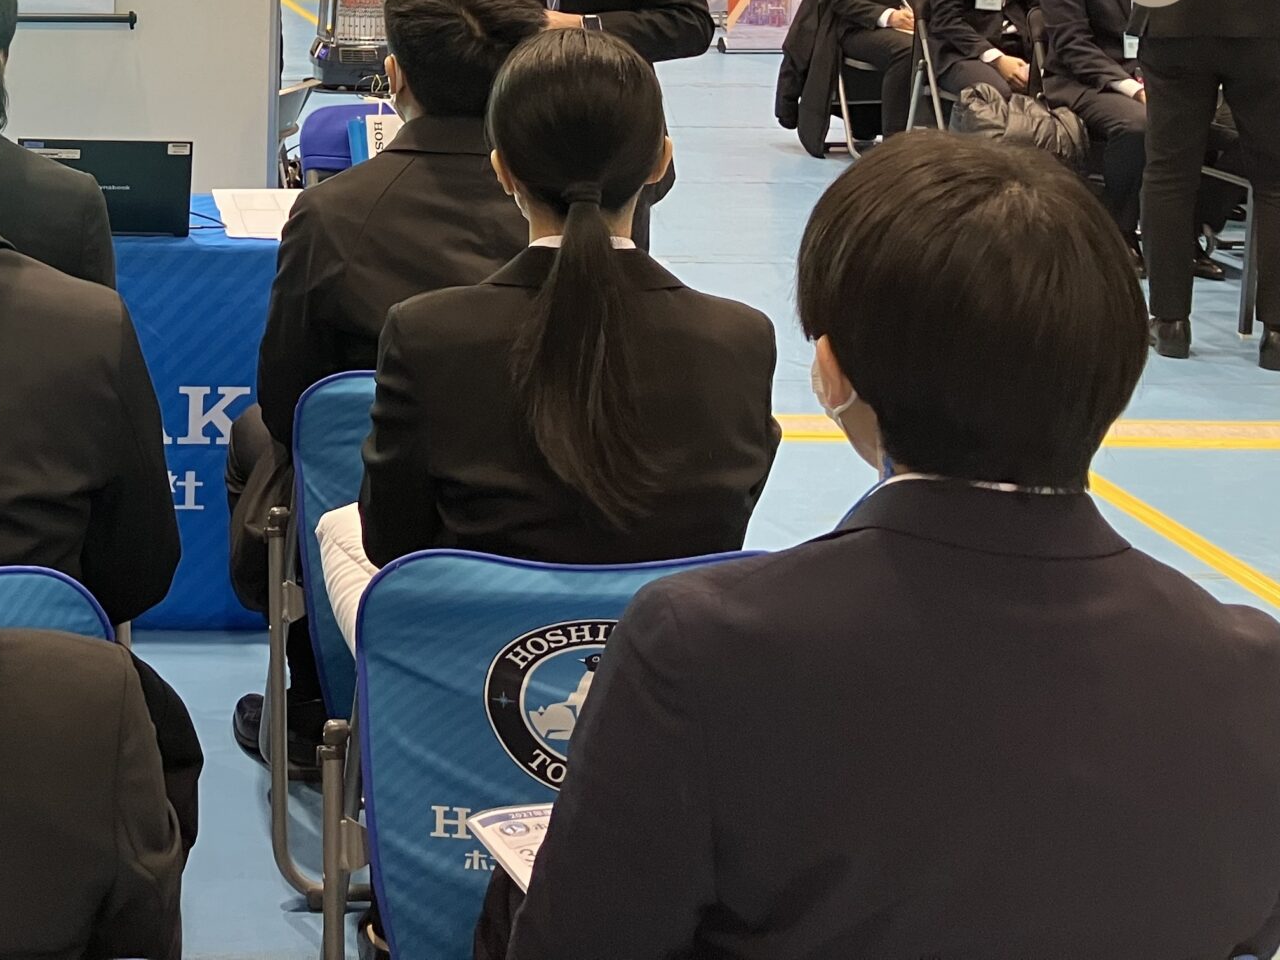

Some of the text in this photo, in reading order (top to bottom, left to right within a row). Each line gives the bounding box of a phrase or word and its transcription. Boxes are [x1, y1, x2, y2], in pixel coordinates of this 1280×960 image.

[163, 386, 251, 444] K
[505, 624, 616, 670] HOSHI
[528, 749, 567, 783] TO
[464, 849, 497, 871] ホ
